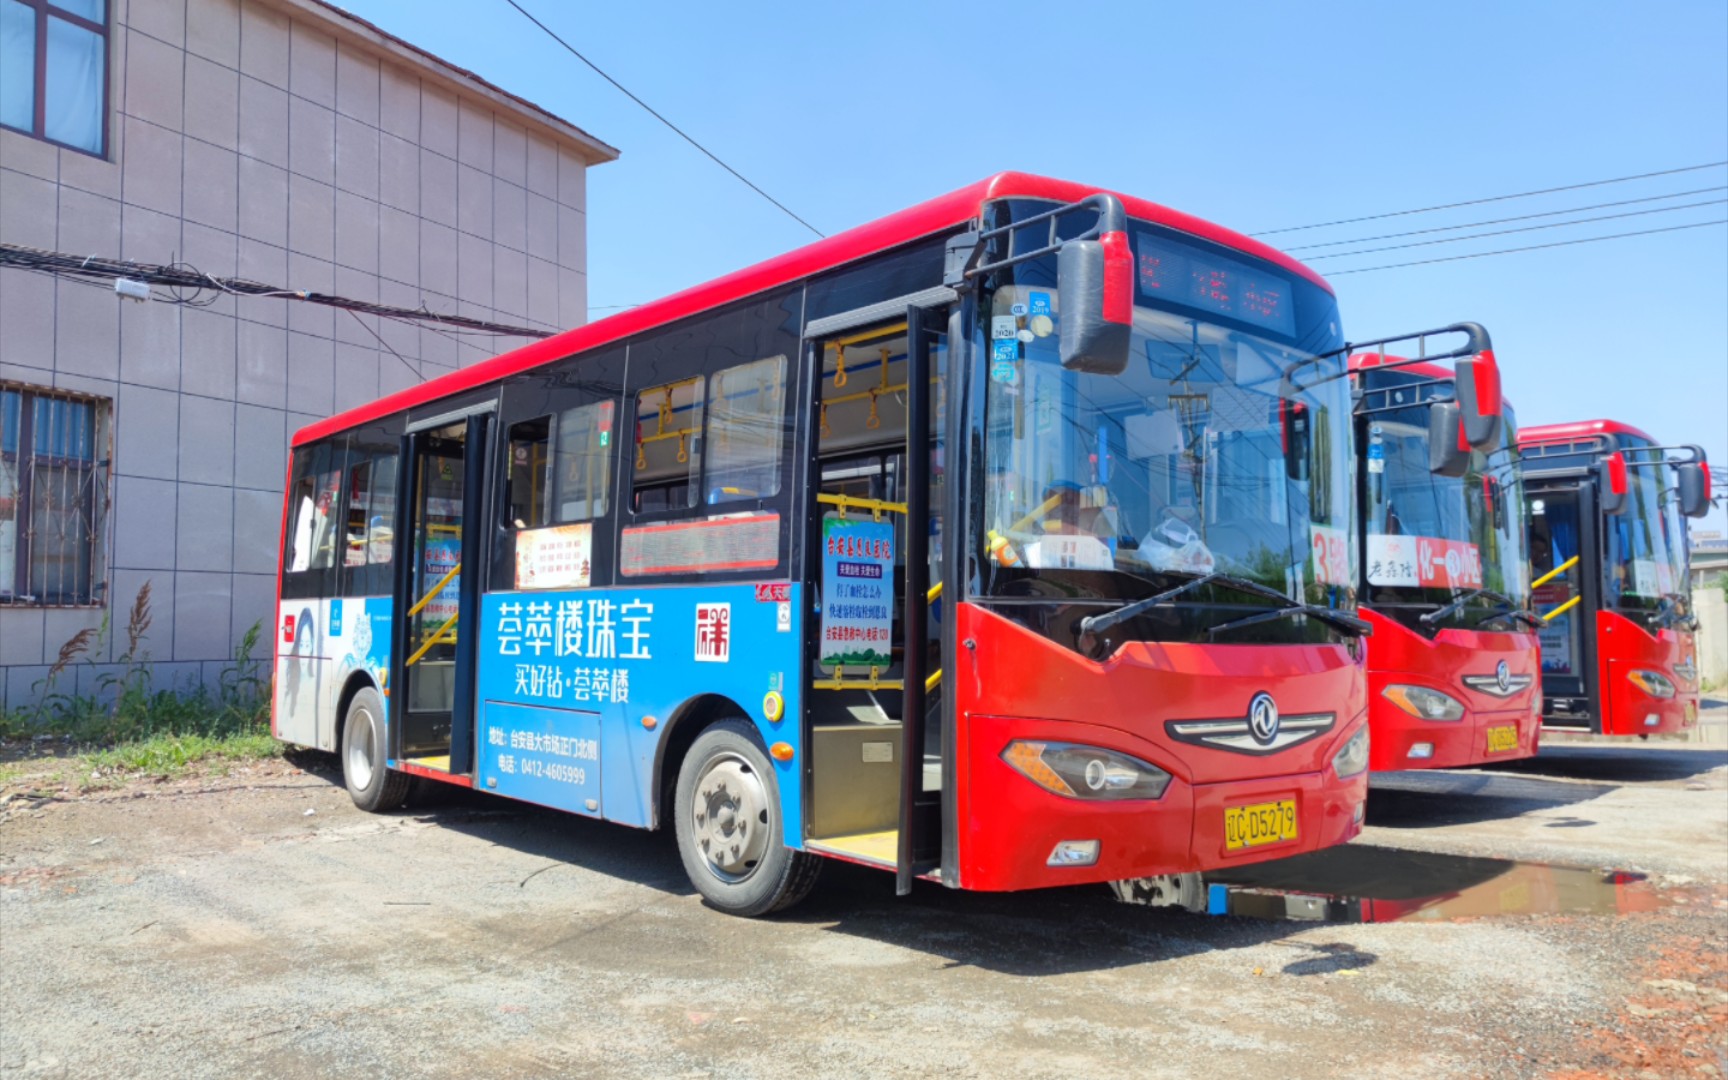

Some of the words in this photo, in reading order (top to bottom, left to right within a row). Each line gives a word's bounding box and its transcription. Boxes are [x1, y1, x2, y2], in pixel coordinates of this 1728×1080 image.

[497, 598, 654, 660] 荟萃楼珠宝
